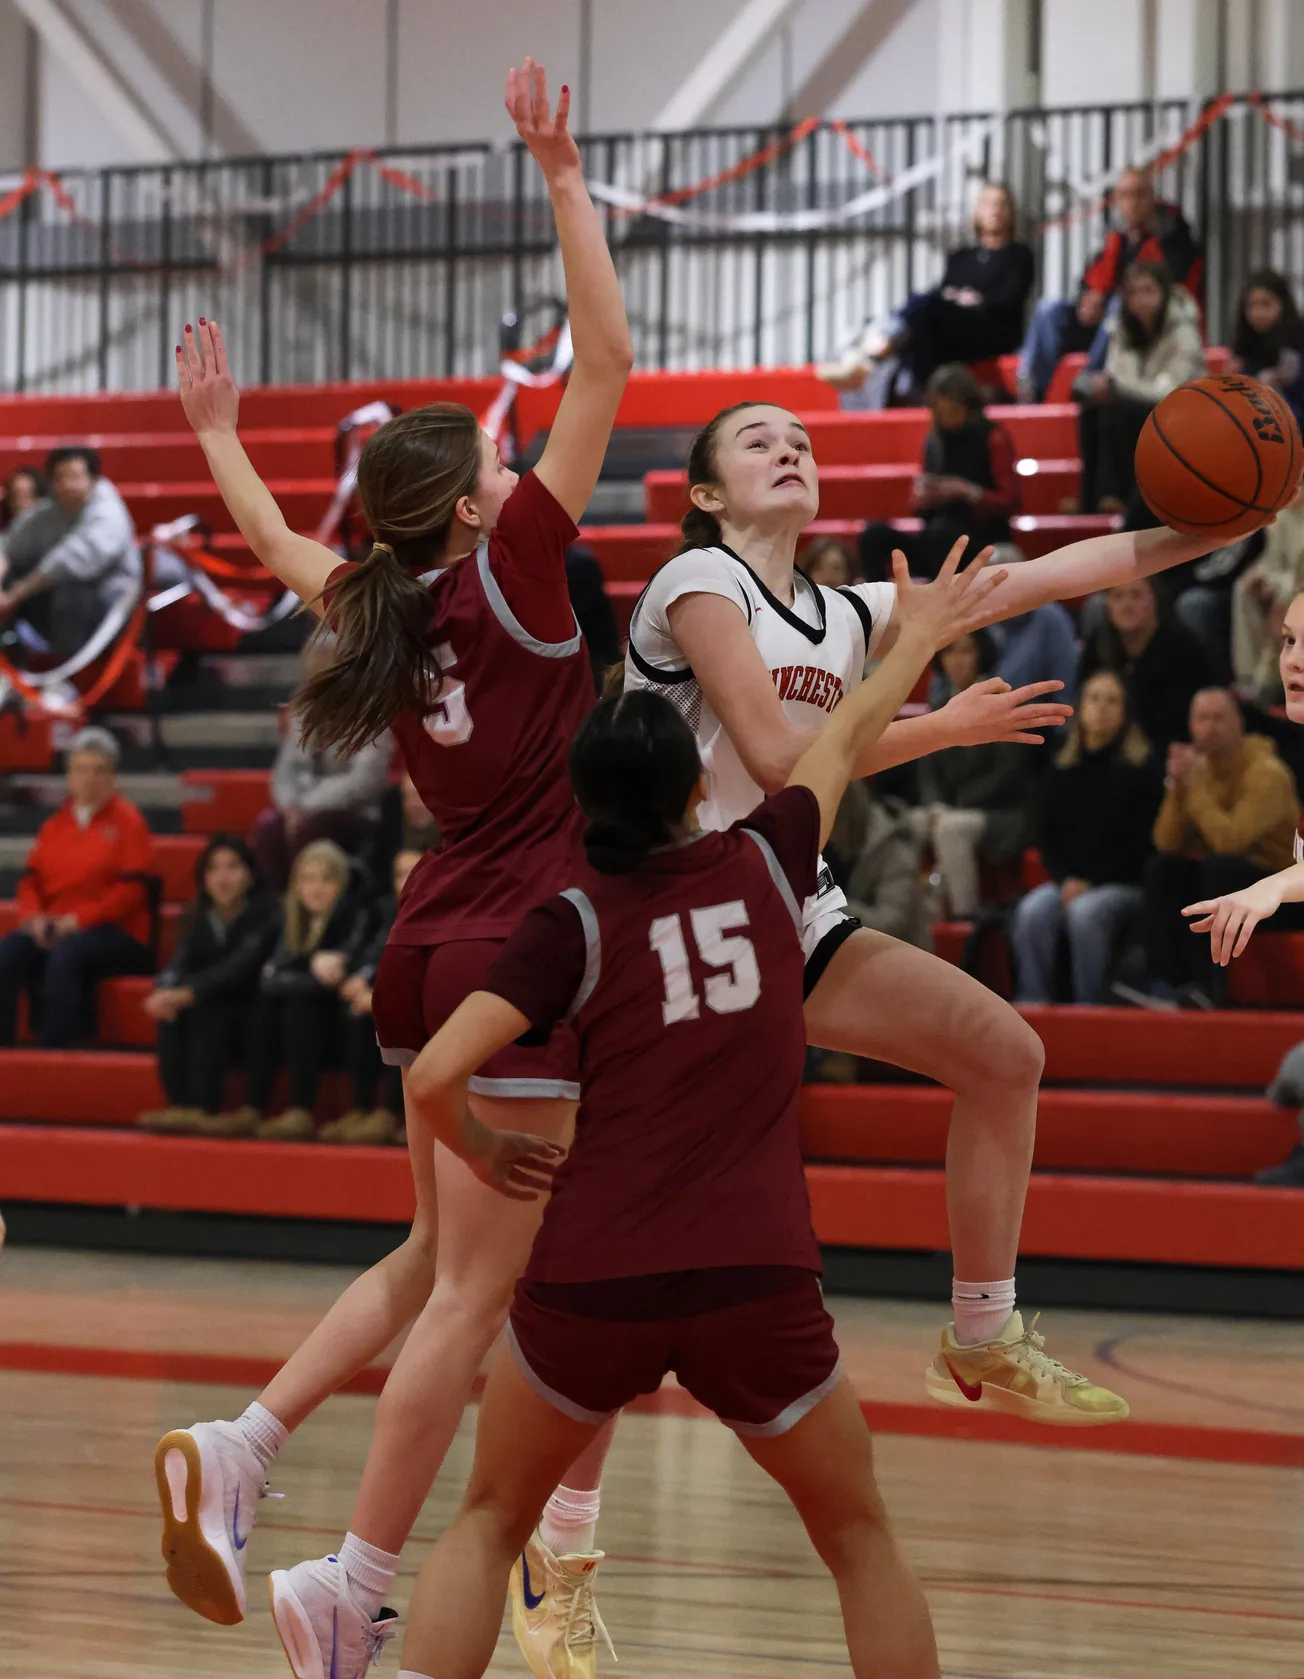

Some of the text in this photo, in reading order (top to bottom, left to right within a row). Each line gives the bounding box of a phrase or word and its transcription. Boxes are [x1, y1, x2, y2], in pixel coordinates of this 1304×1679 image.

[413, 640, 475, 748] 5
[768, 665, 844, 714] INCHEST
[648, 899, 762, 1027] 15
